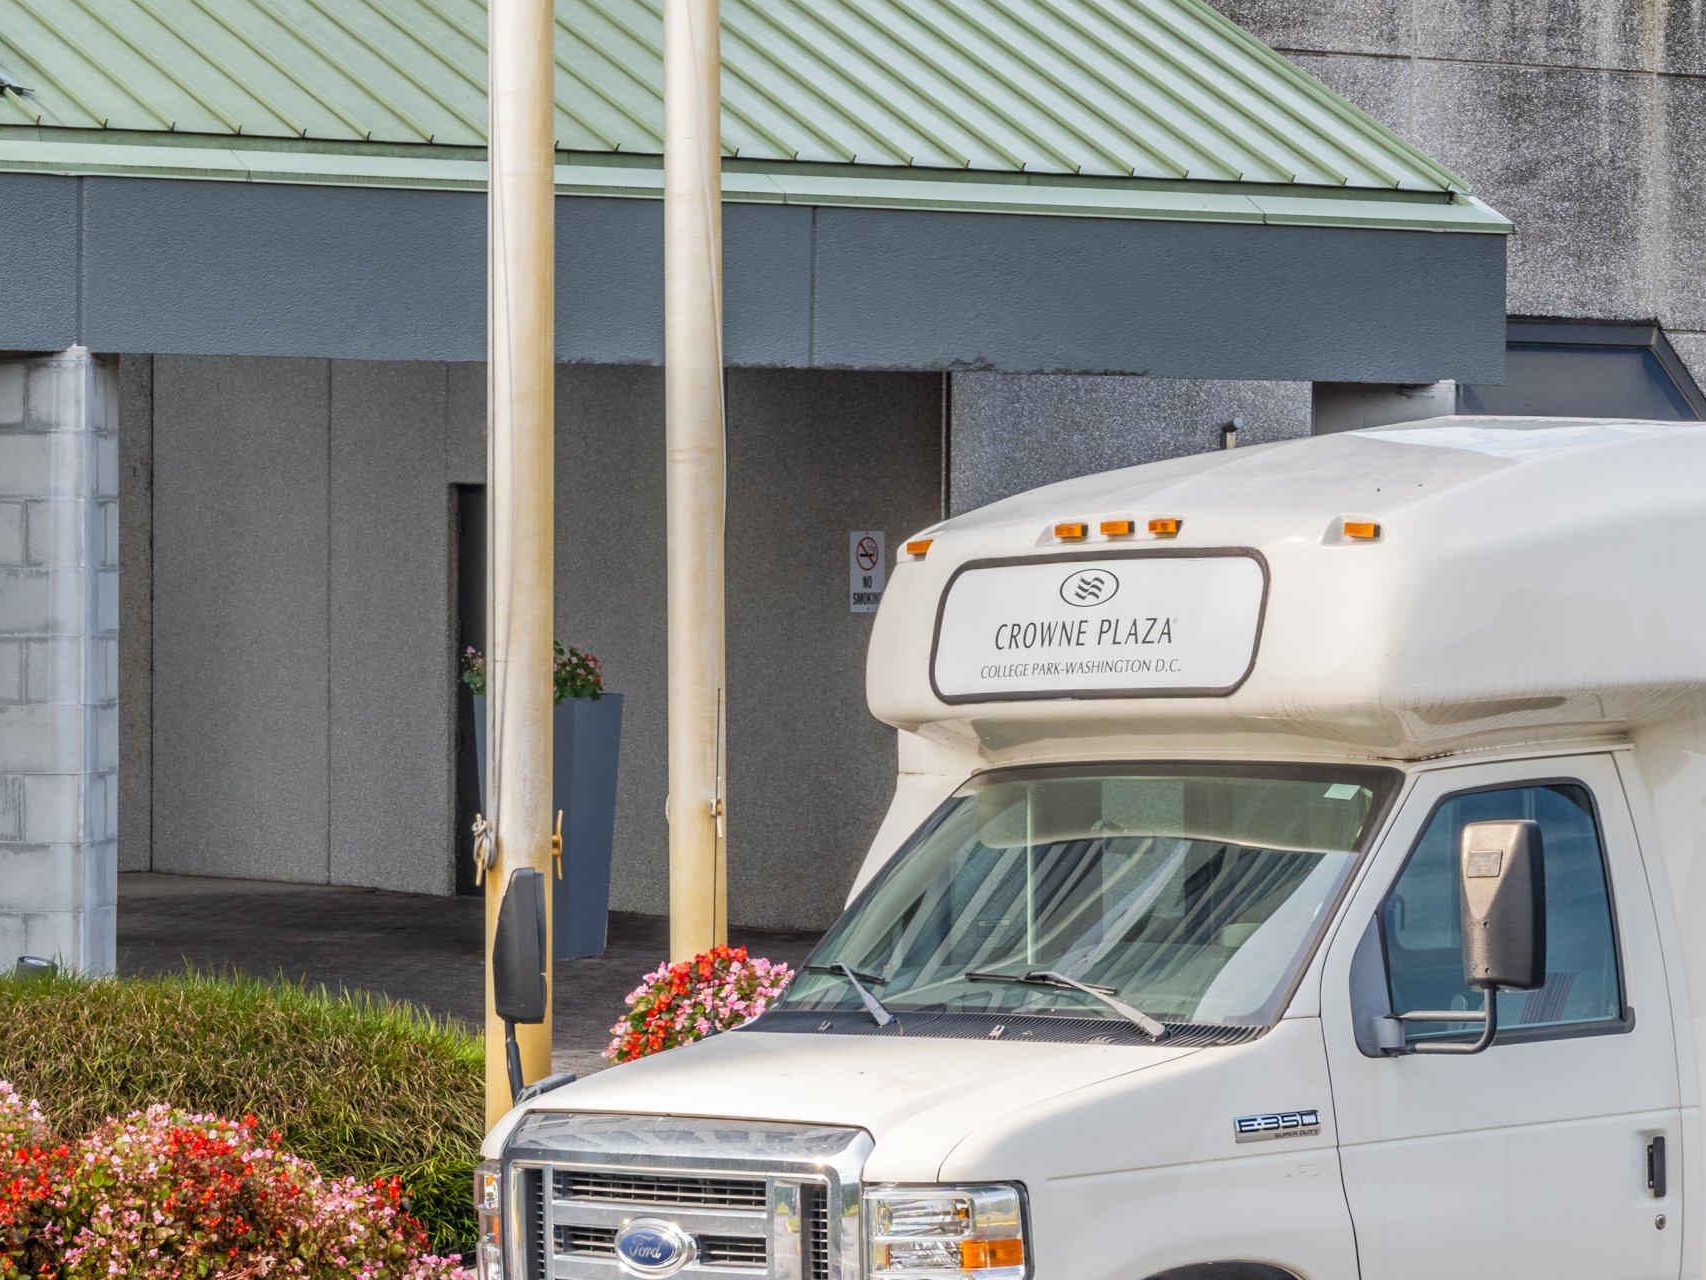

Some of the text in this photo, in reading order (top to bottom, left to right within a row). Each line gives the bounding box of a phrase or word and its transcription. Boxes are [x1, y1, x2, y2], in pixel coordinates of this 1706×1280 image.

[863, 576, 872, 588] NO
[995, 620, 1088, 650] CROWNE
[980, 659, 1181, 678] COLLEGE PARK-WASHINGTON D.C.
[1274, 1128, 1319, 1138] SUPER DUTY
[629, 1234, 662, 1259] Ford
